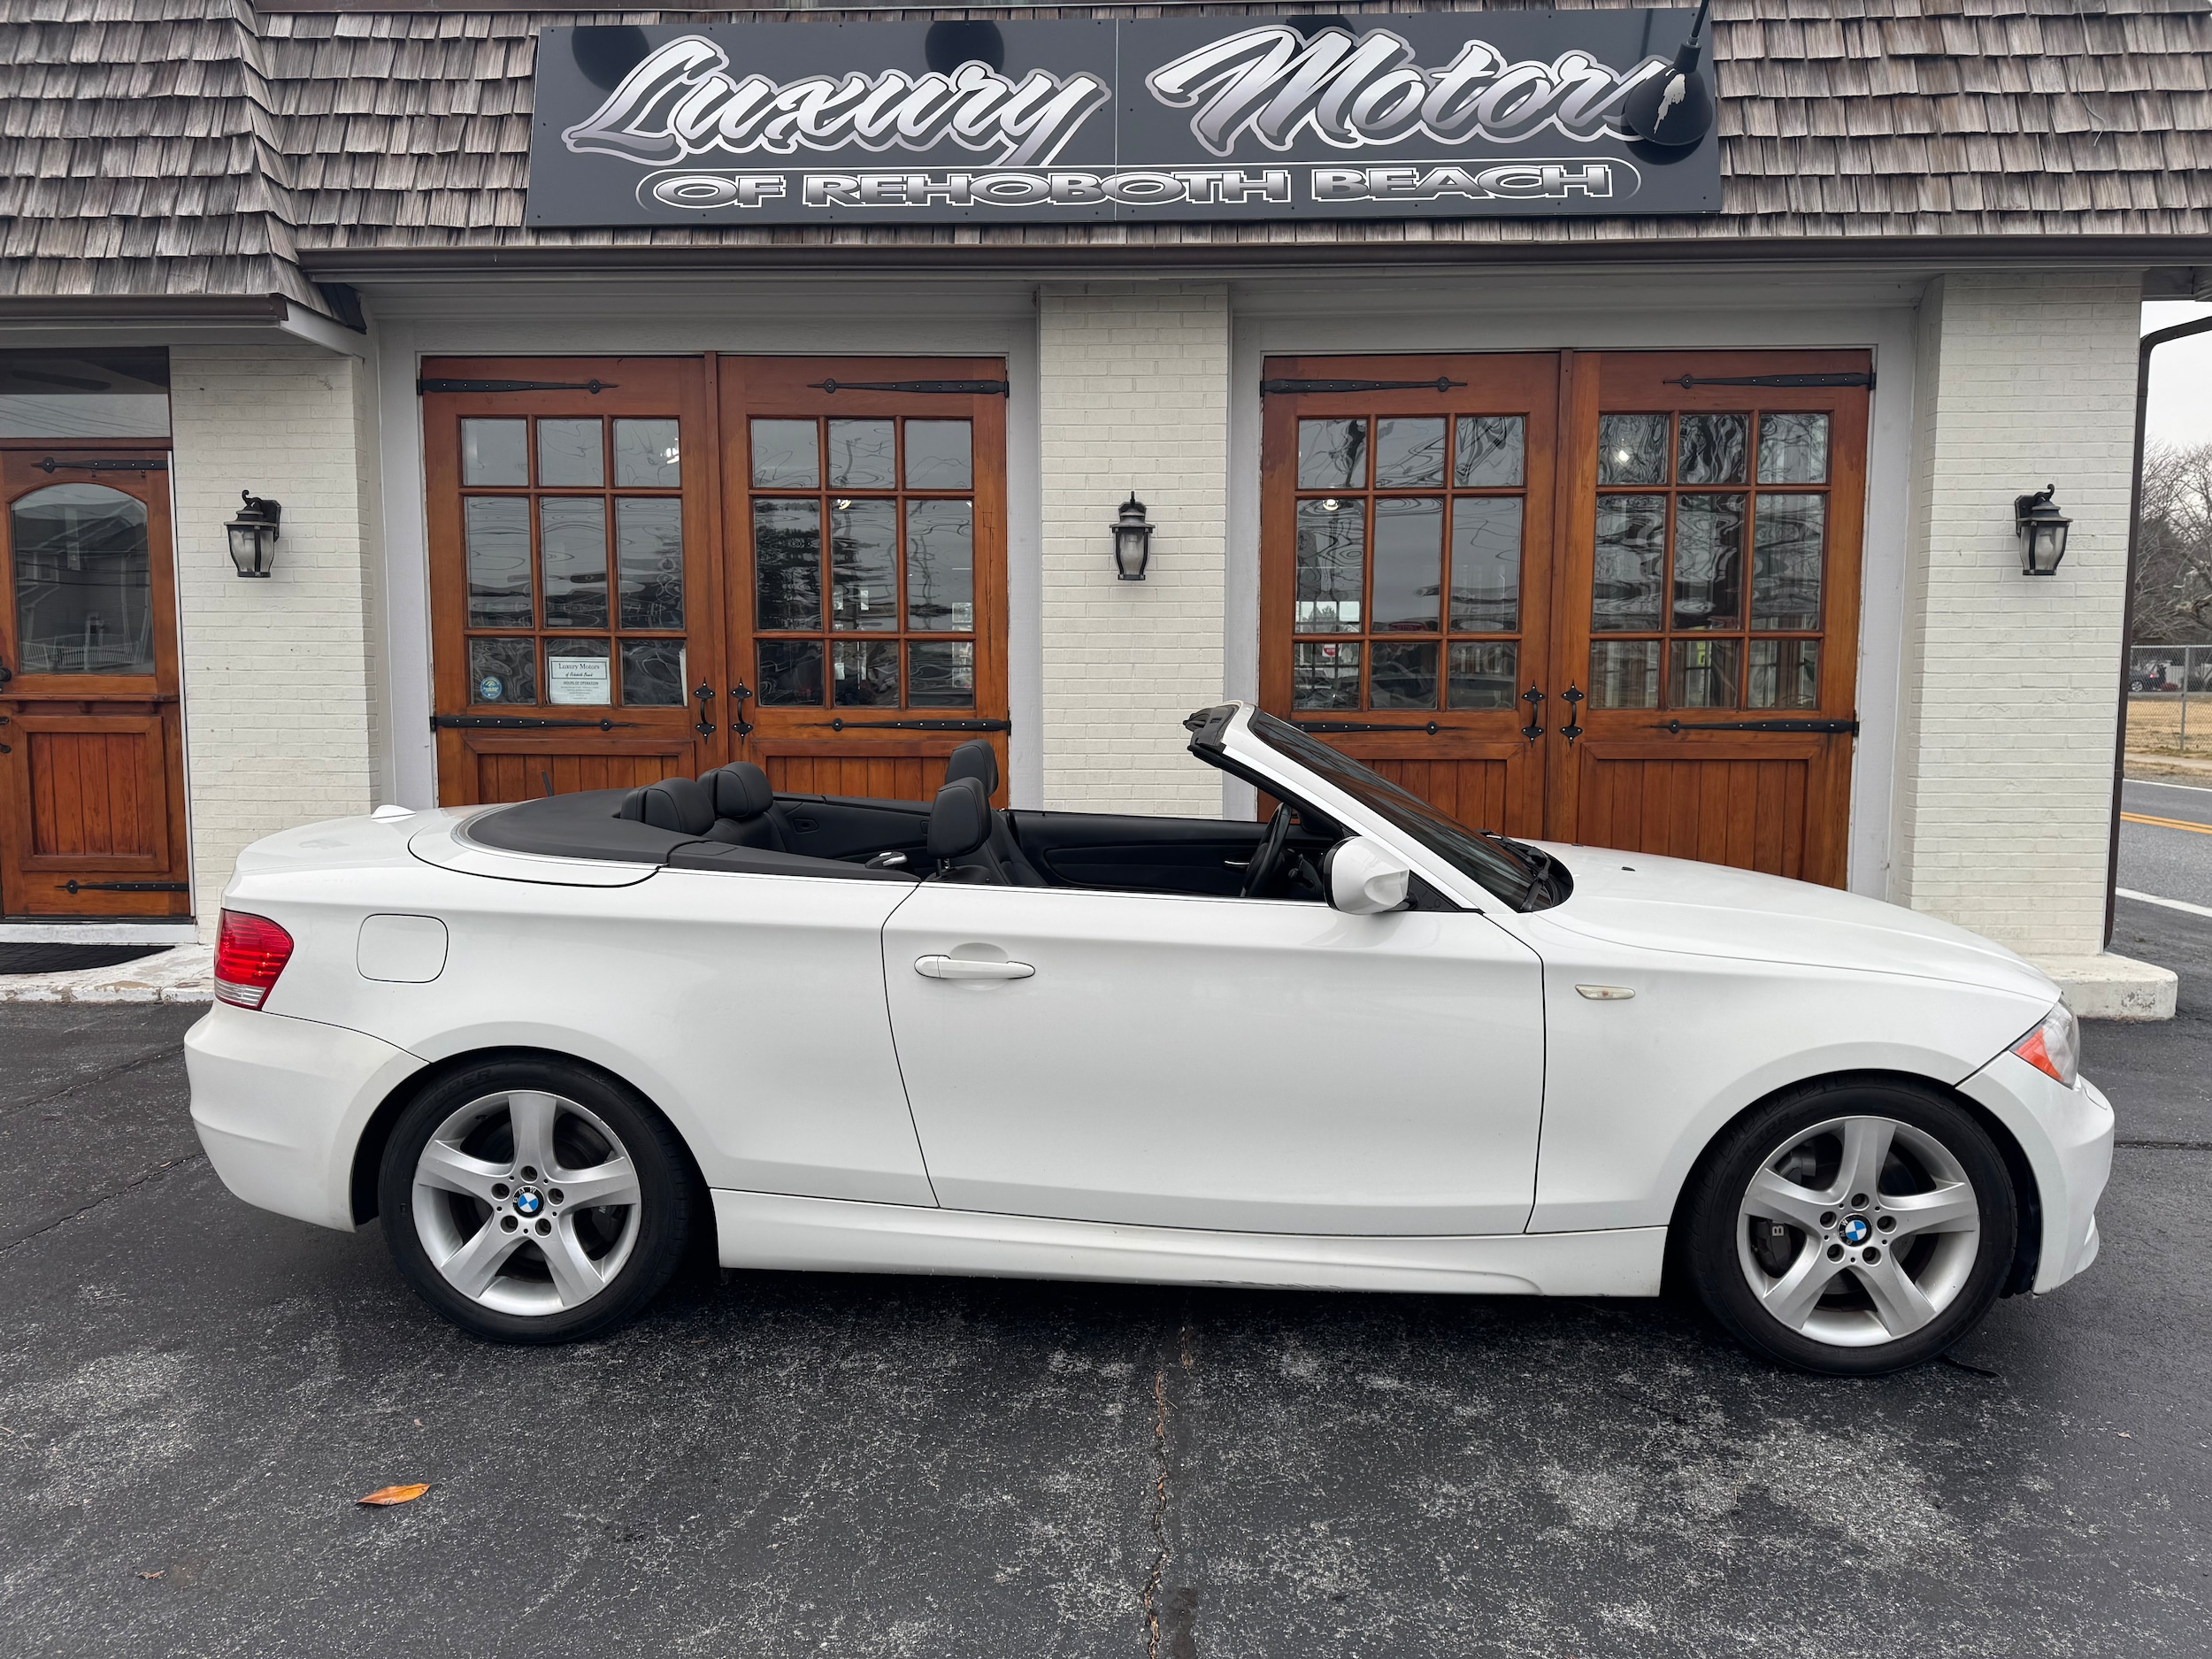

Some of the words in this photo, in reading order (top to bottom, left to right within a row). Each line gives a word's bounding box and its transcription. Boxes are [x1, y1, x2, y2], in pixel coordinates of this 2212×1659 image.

[562, 35, 1110, 166] Luxury
[653, 174, 786, 209] OF
[803, 171, 1291, 207] REHOBOTH
[1311, 165, 1613, 202] BEACH
